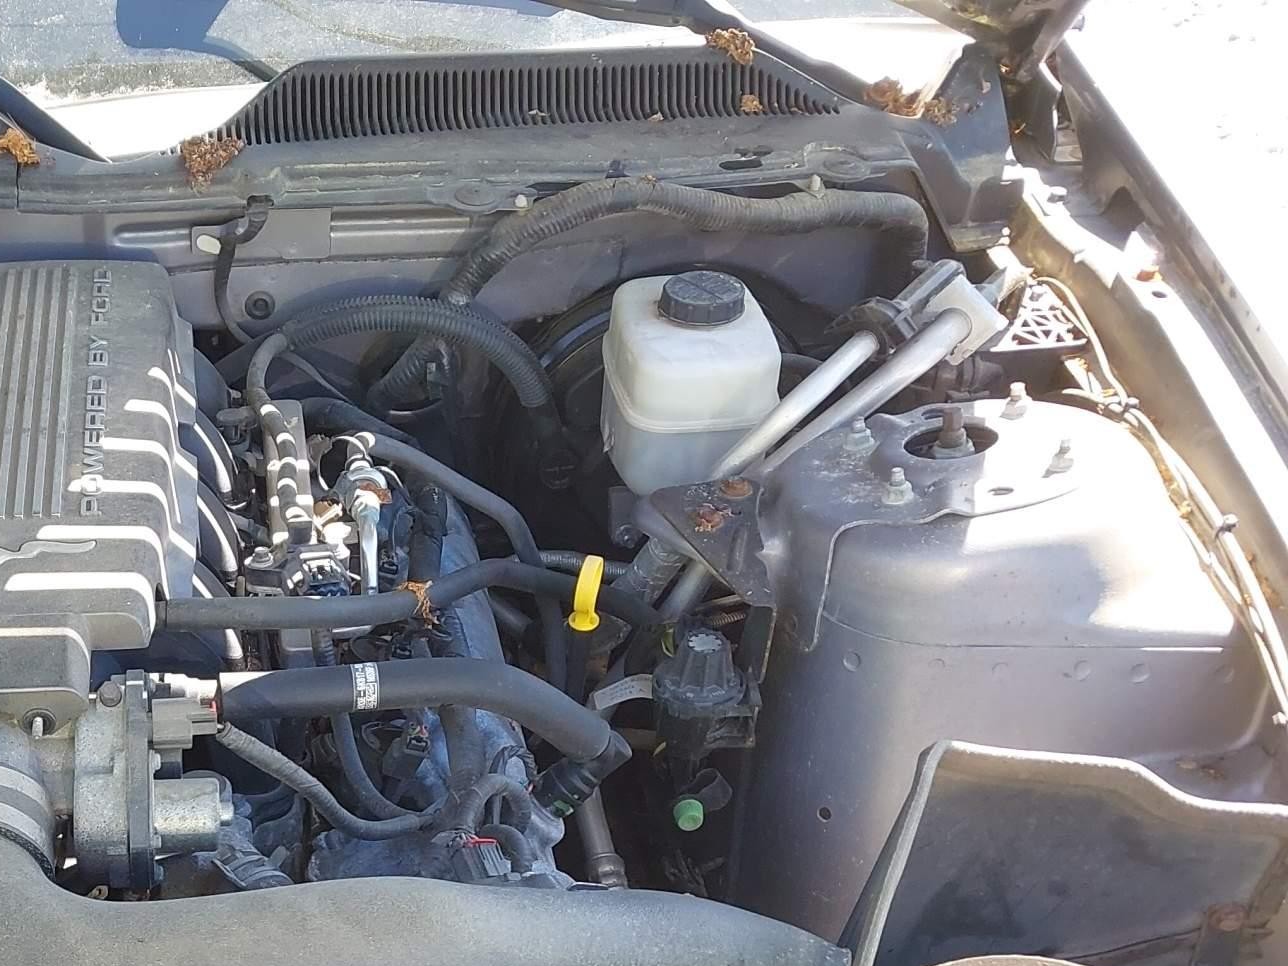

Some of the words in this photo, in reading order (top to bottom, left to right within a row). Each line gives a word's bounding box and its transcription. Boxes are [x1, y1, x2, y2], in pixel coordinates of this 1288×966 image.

[90, 267, 112, 327] FORD
[88, 335, 110, 367] BY
[80, 374, 107, 517] POWERED
